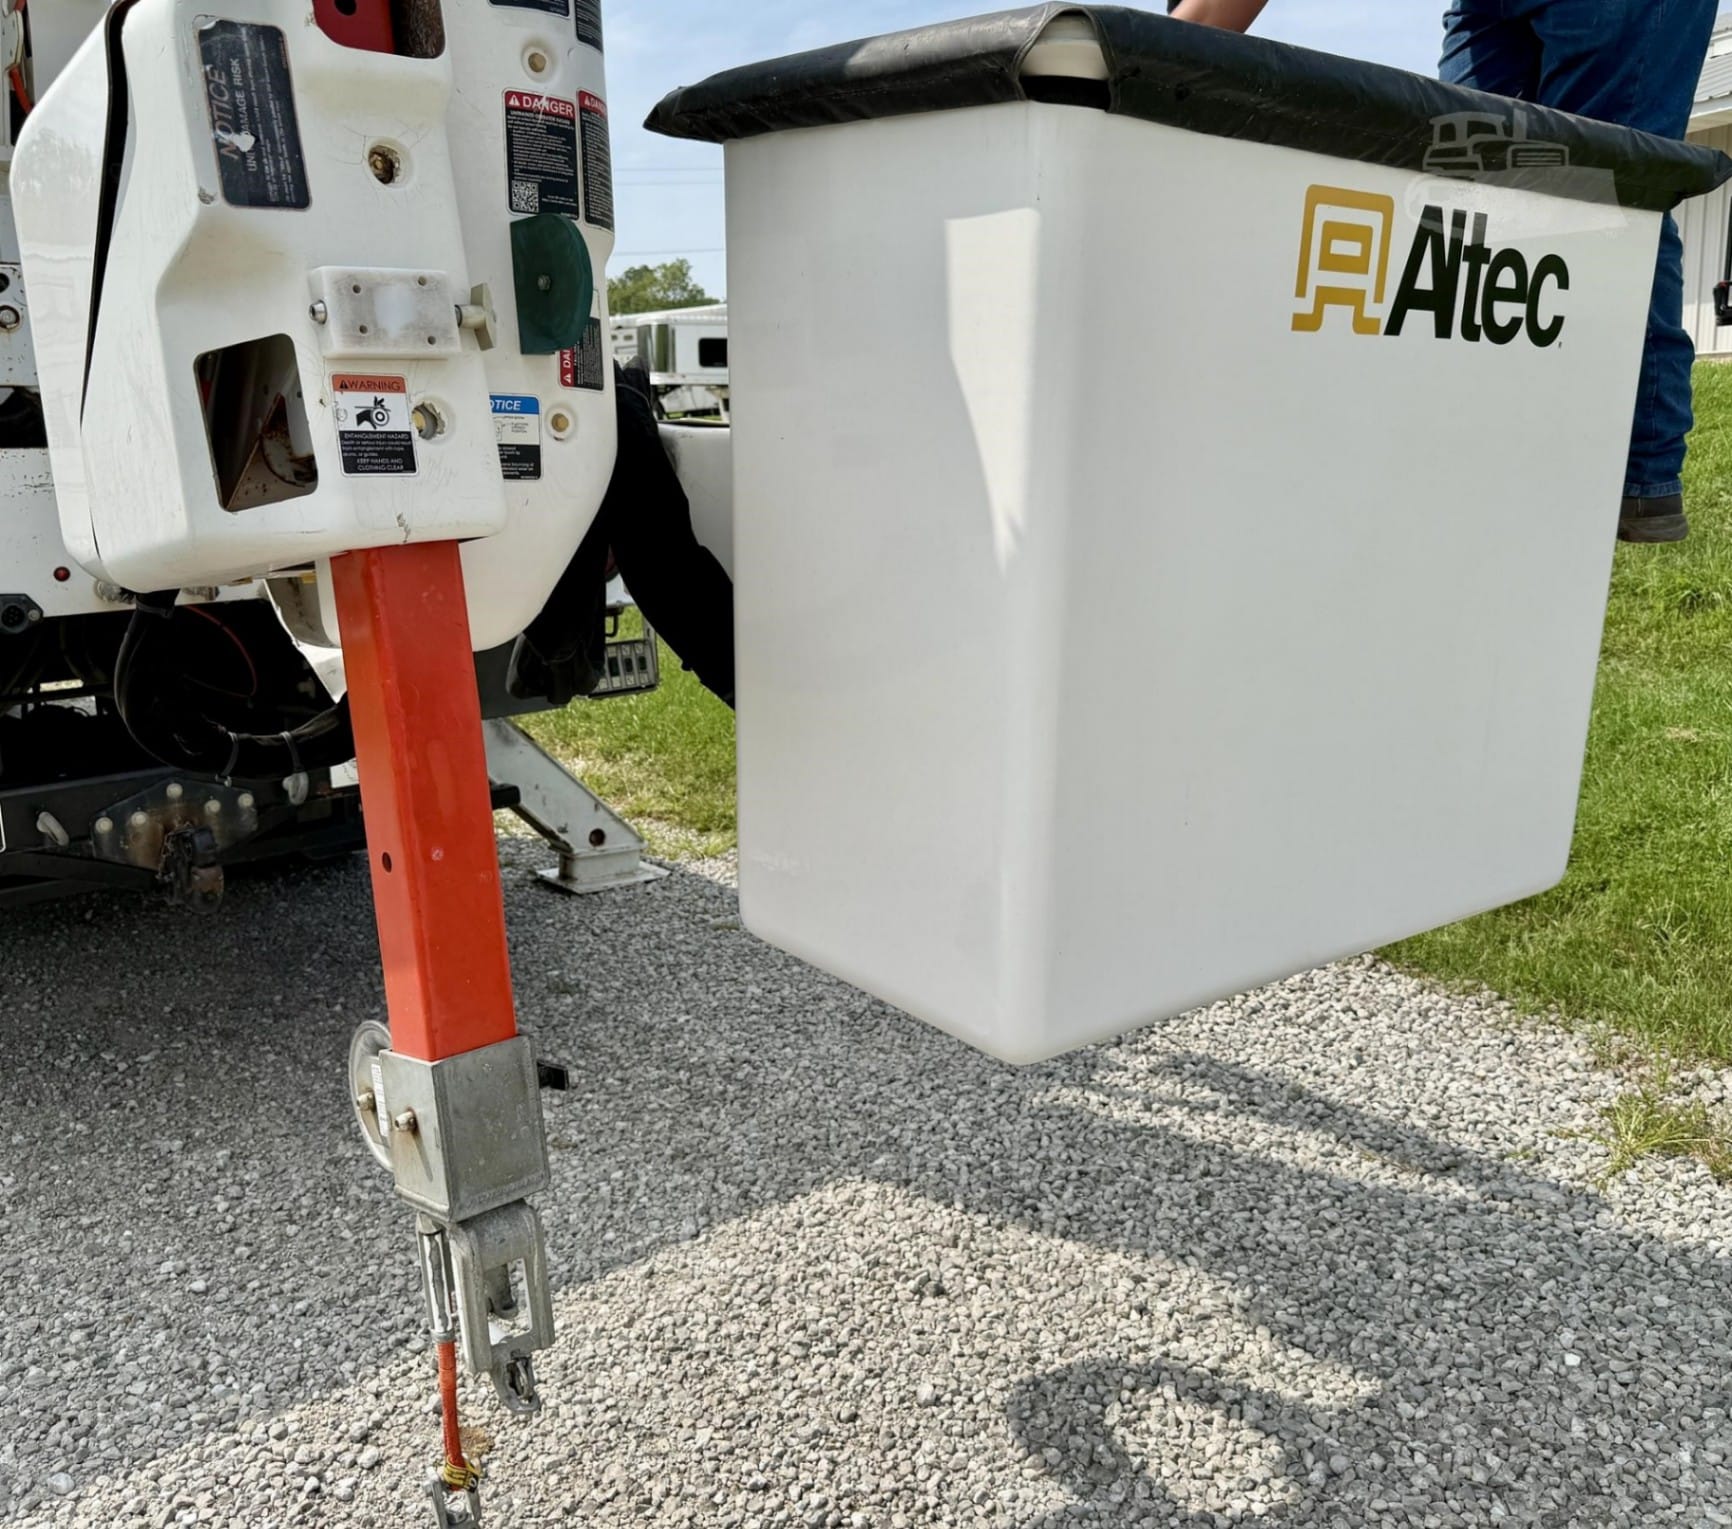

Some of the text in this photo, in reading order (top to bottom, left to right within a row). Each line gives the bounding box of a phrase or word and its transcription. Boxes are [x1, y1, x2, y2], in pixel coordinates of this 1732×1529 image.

[230, 58, 244, 86] RISK
[208, 68, 239, 160] NOTICE
[522, 95, 574, 117] DANGER
[1383, 204, 1570, 348] Altec
[350, 380, 401, 391] WARNING
[490, 399, 522, 411] TICE
